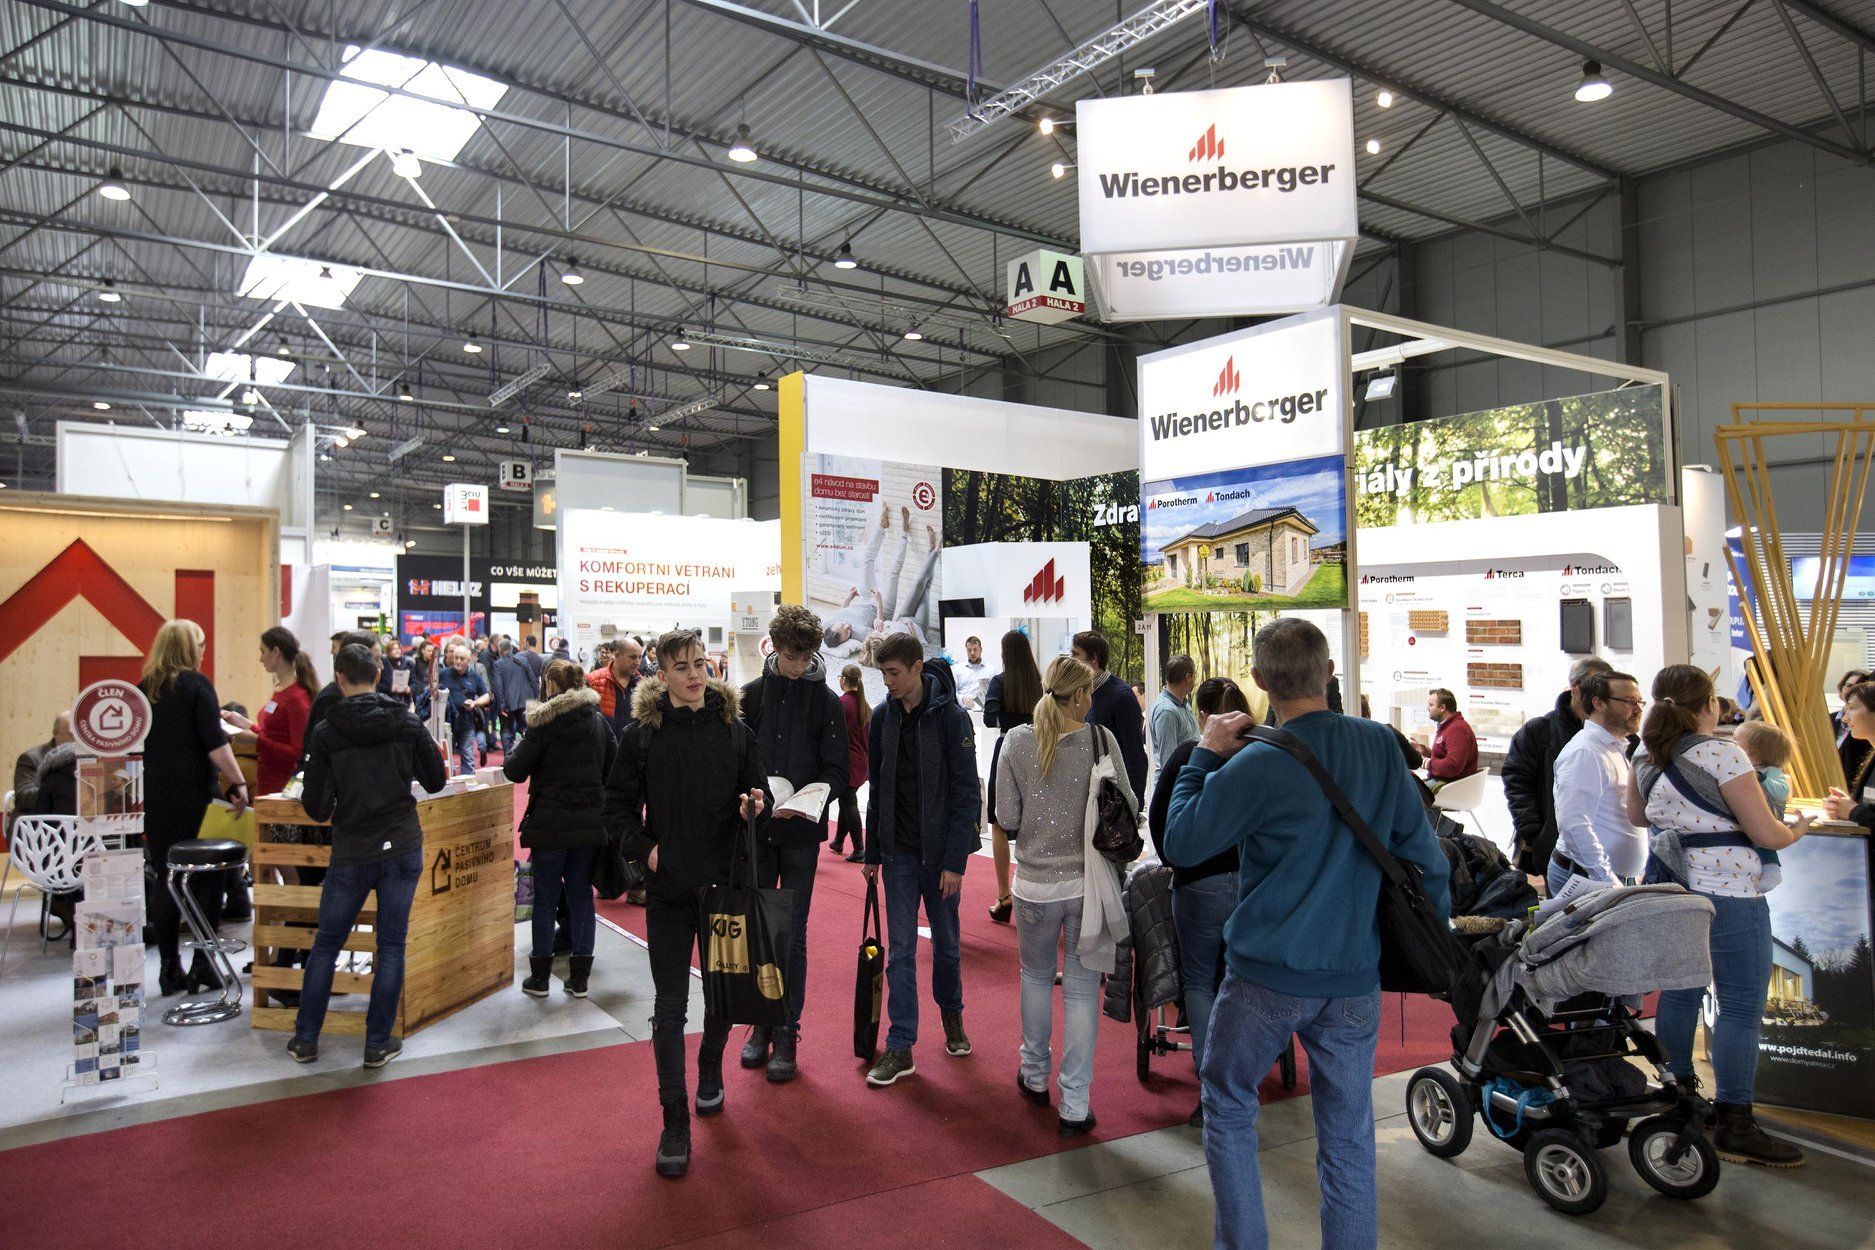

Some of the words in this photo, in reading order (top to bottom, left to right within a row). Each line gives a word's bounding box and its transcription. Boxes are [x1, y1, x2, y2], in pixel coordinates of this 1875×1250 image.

[1099, 163, 1336, 199] Wienerberger
[1014, 261, 1034, 298] A
[1049, 260, 1077, 296] A
[1012, 300, 1031, 314] HALA
[1031, 298, 1037, 307] 2
[1046, 297, 1072, 310] HALA
[1072, 303, 1080, 312] 2
[1150, 388, 1328, 441] Wienerberger
[512, 464, 526, 479] B
[1355, 458, 1413, 497] iály
[1452, 441, 1587, 491] přírody
[814, 488, 834, 496] domu
[835, 490, 847, 498] bez
[824, 479, 845, 488] návod
[855, 481, 877, 491] stavbu
[1157, 496, 1198, 509] Porotherm
[1215, 488, 1251, 503] Tondach
[1093, 501, 1140, 527] Zdra
[379, 519, 389, 530] C
[490, 566, 504, 576] CO
[506, 564, 524, 577] VŠE
[1496, 570, 1525, 579] Terca
[579, 579, 590, 593] S
[593, 580, 691, 596] REKUPERACÍ
[1370, 575, 1415, 584] Porotherm
[97, 687, 125, 698] ČLEN
[80, 719, 95, 742] CENTRA
[96, 736, 132, 748] PASIVNÍHO
[130, 716, 143, 739] DOMU
[455, 871, 479, 888] DOMU
[716, 959, 739, 970] QALITY
